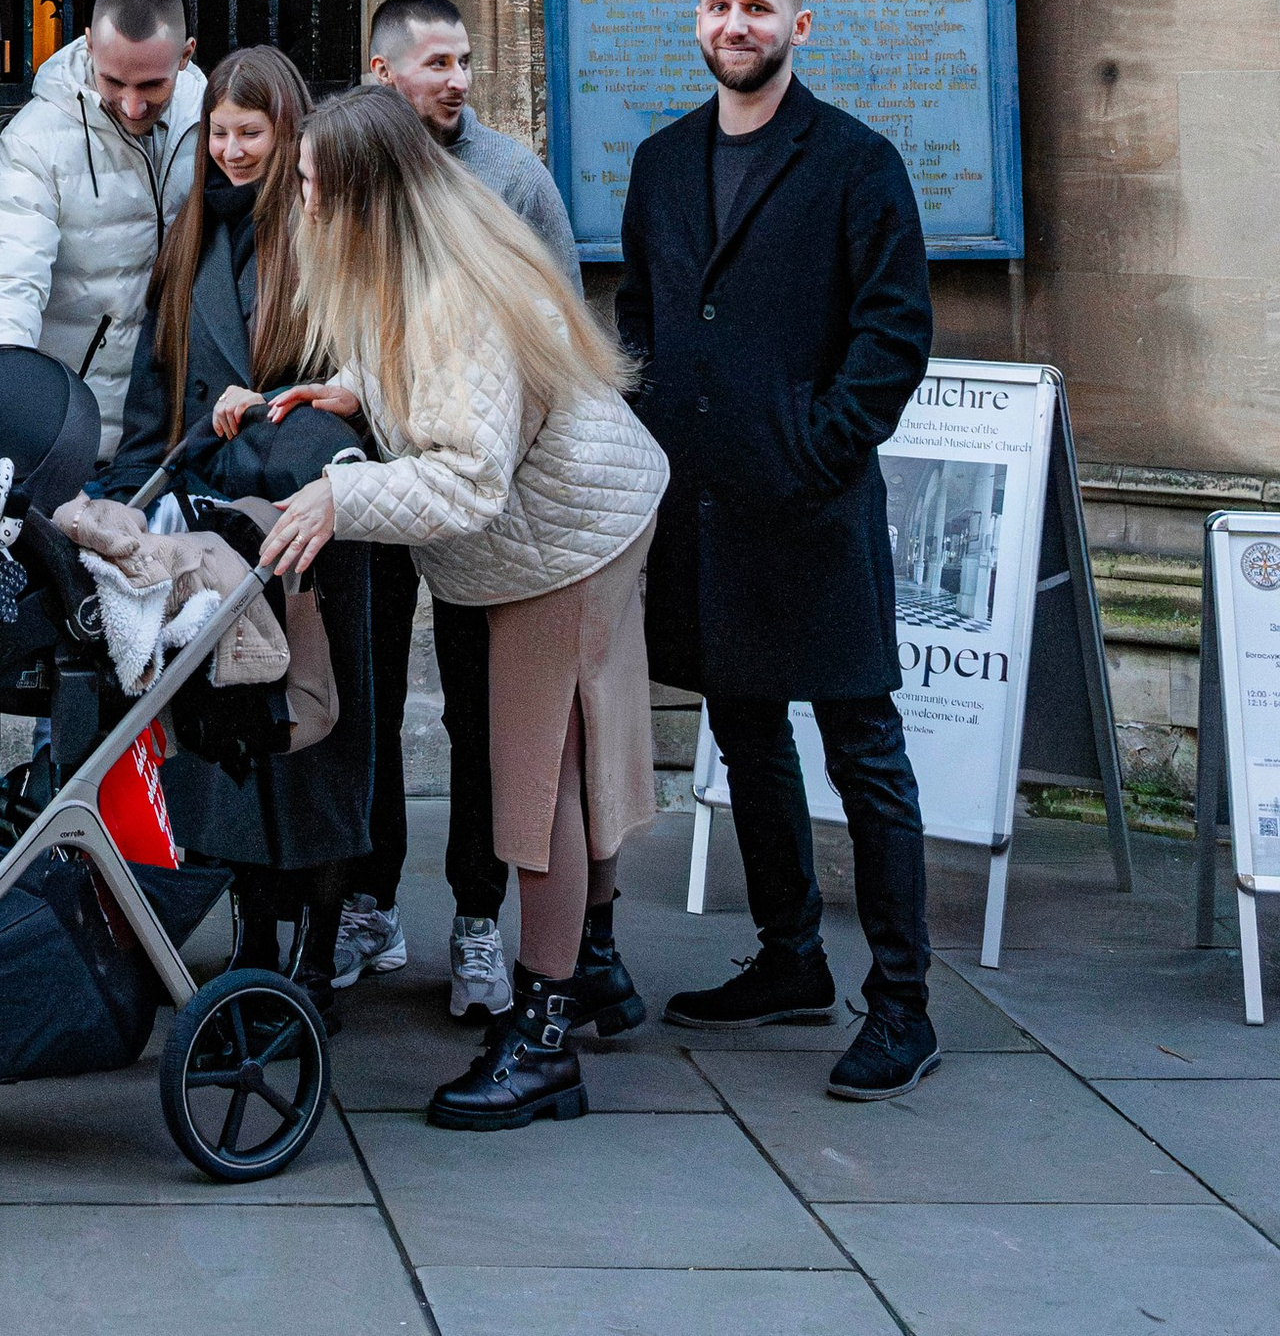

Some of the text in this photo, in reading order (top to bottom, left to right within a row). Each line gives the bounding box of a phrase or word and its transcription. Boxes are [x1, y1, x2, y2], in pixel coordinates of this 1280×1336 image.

[907, 49, 929, 61] and
[870, 64, 902, 77] Great
[855, 96, 871, 108] the
[877, 96, 916, 108] church
[921, 99, 939, 108] are
[900, 140, 918, 152] the
[919, 154, 941, 166] and
[923, 199, 942, 210] the
[909, 379, 1010, 410] ulchre
[939, 421, 970, 435] Home
[971, 423, 983, 435] of
[983, 424, 1000, 436] the
[903, 434, 943, 447] National
[995, 439, 1032, 454] Church
[897, 641, 1010, 688] open
[896, 692, 949, 707] community
[910, 708, 955, 723] welcome
[955, 713, 966, 724] to
[913, 724, 935, 735] below
